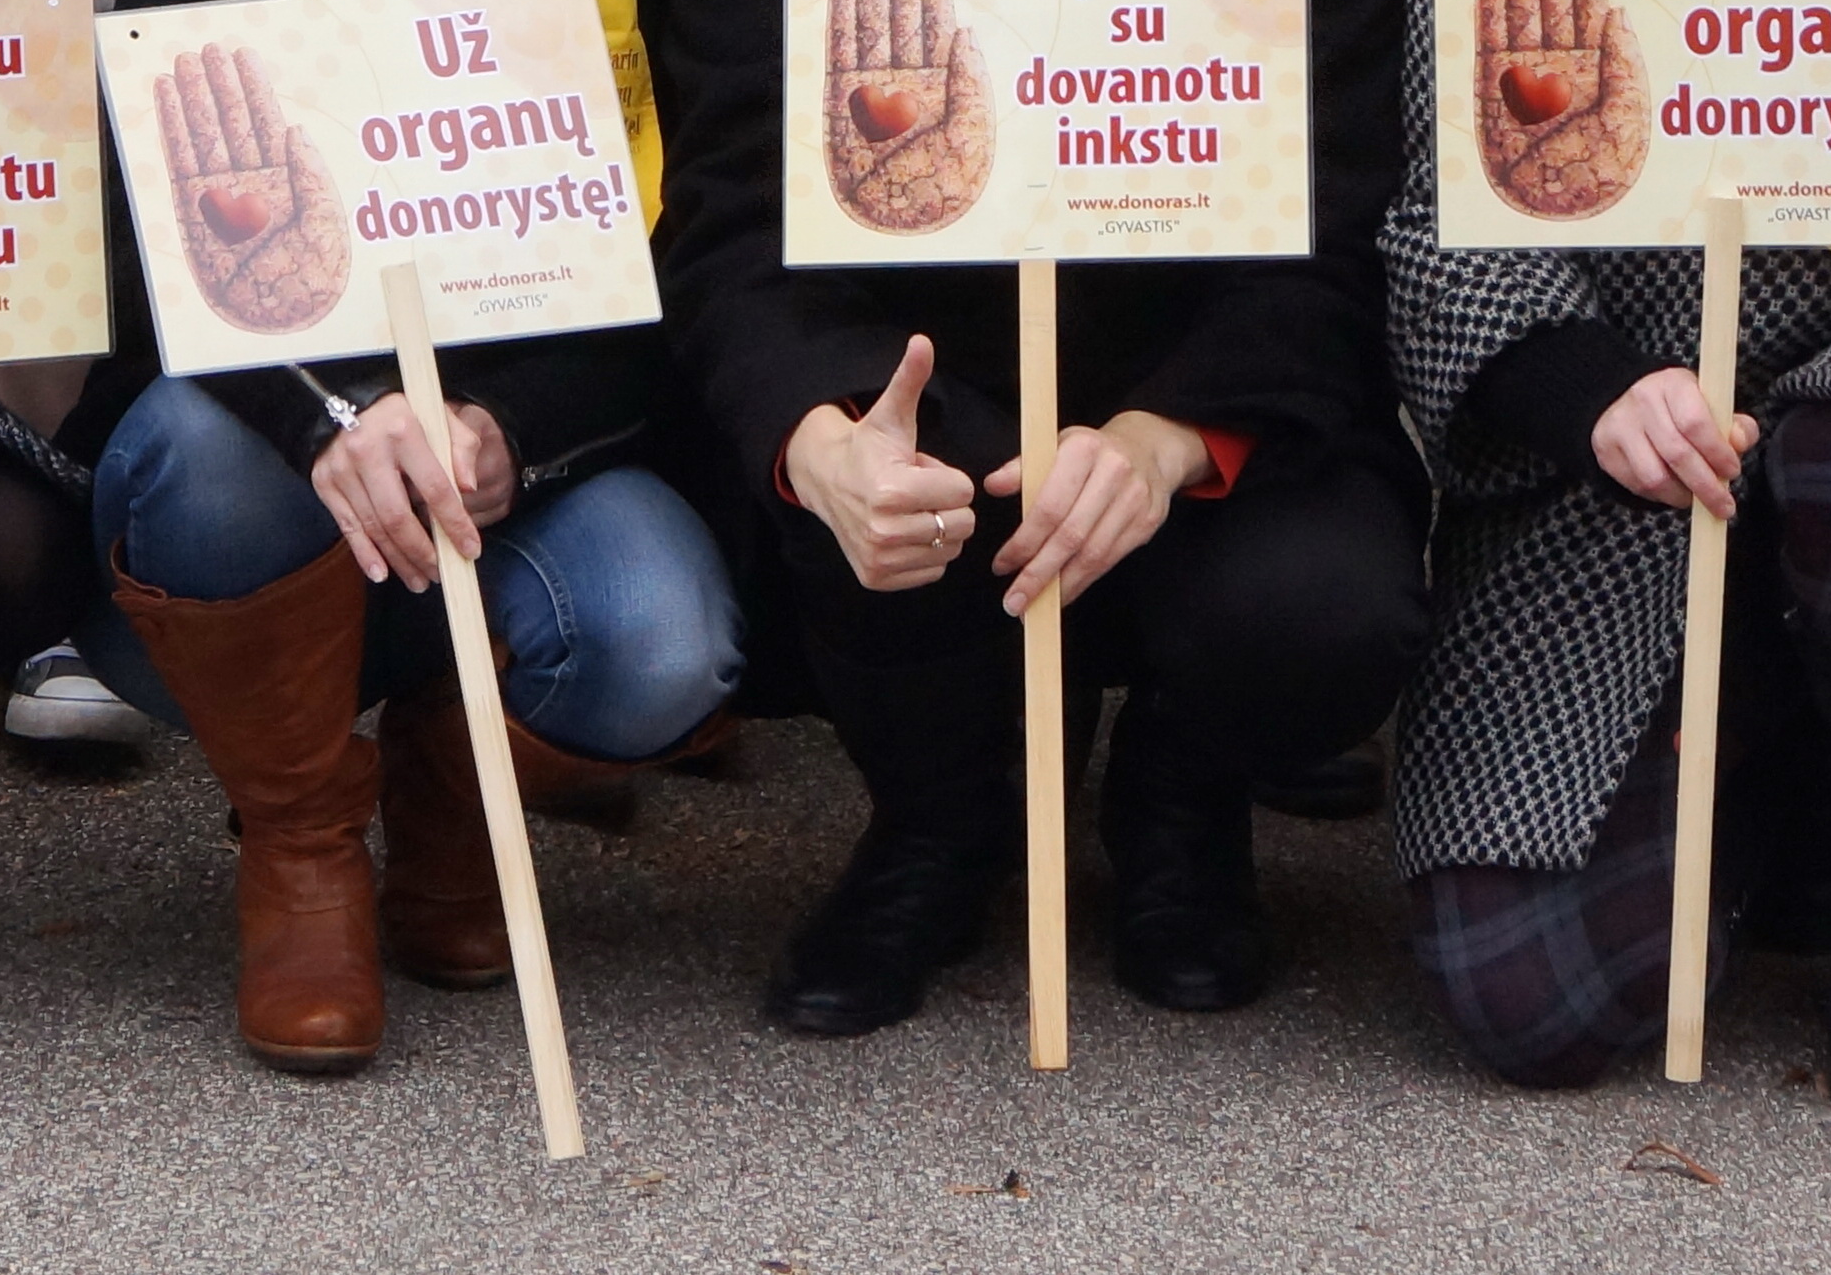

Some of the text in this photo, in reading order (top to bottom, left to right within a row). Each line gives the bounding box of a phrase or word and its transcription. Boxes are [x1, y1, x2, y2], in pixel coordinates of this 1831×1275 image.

[416, 12, 497, 77] Už
[1111, 8, 1164, 42] su
[1017, 58, 1260, 105] dovanotu
[362, 96, 595, 171] organų
[1059, 116, 1217, 164] inkstu
[356, 165, 627, 241] donorystę!
[1068, 193, 1210, 210] www.donoras.lt
[440, 265, 573, 295] www.donoras.lt
